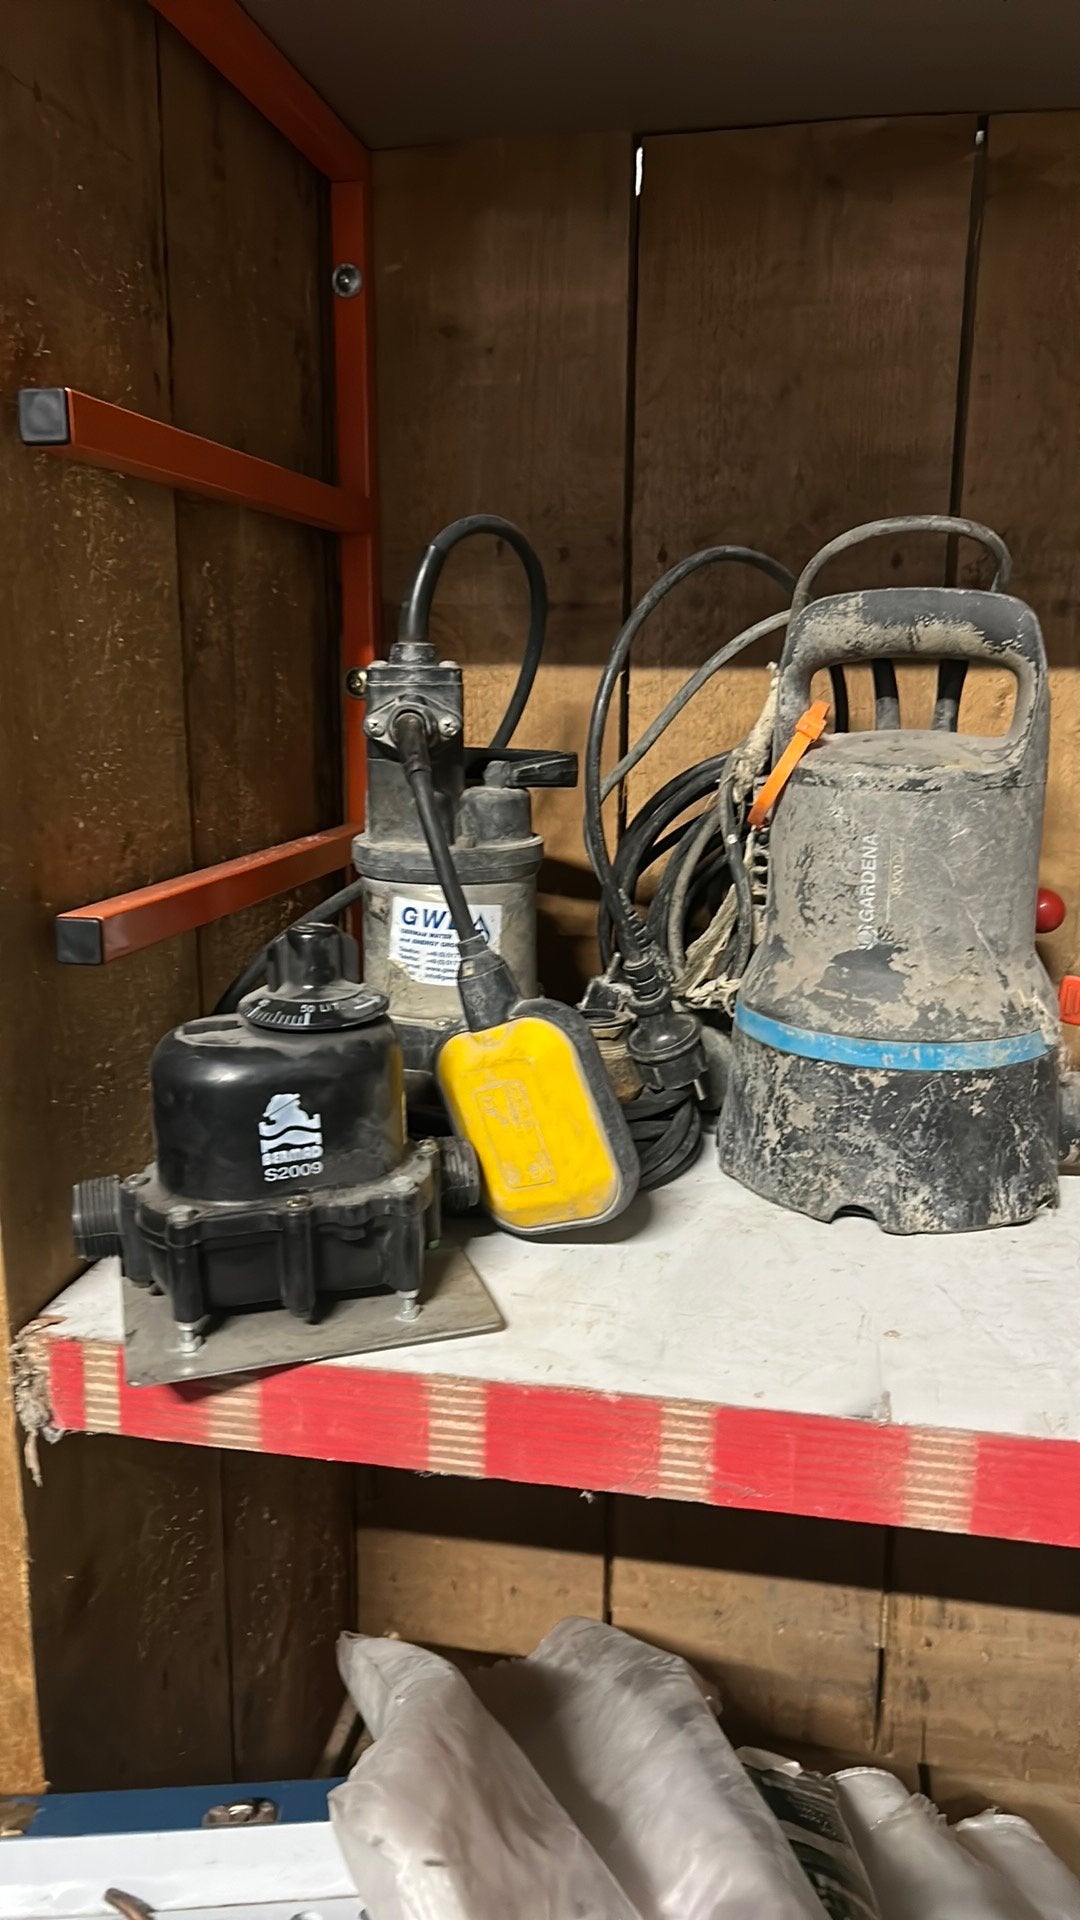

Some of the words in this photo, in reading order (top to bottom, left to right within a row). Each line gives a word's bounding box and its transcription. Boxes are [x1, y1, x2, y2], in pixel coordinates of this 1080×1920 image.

[859, 834, 879, 922] GARDENA
[402, 906, 458, 930] GW
[264, 1161, 324, 1182] S2009
